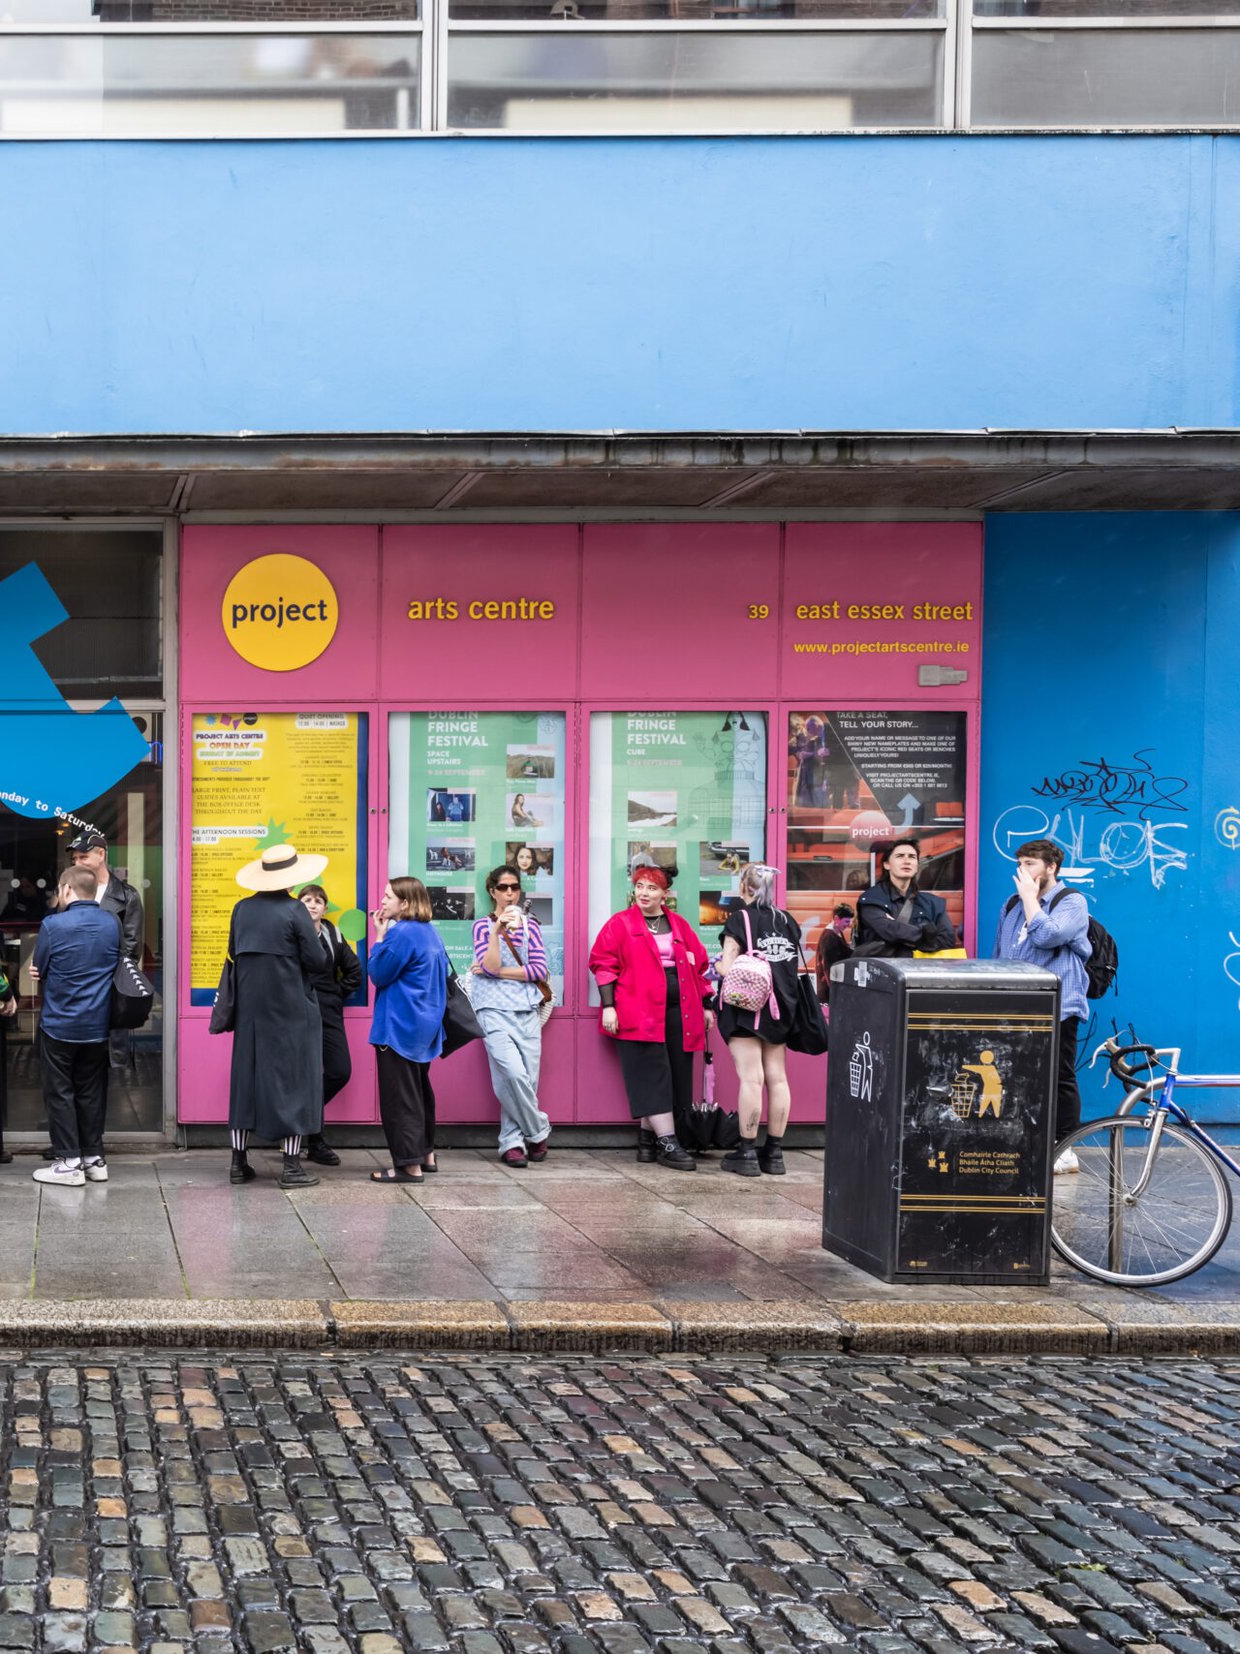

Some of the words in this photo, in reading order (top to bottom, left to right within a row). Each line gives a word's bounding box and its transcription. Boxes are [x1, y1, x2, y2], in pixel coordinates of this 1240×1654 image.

[232, 596, 328, 629] project
[408, 597, 459, 620] arts
[468, 597, 555, 620] centre
[748, 604, 769, 619] 39
[796, 601, 840, 619] east
[847, 604, 905, 620] essex
[913, 602, 973, 621] street
[793, 640, 970, 656] www.projectartscentre.ie
[428, 721, 478, 733] FRINGE
[627, 719, 676, 731] FRINGE
[840, 720, 858, 728] TELL
[861, 720, 885, 728] YOUR
[427, 735, 489, 747] FESTIVAL
[627, 733, 687, 745] FESTIVAL
[35, 799, 49, 812] to
[851, 826, 889, 838] project
[959, 1150, 991, 1158] Comhairle
[992, 1151, 1020, 1159] Cathrach
[981, 1166, 994, 1175] City
